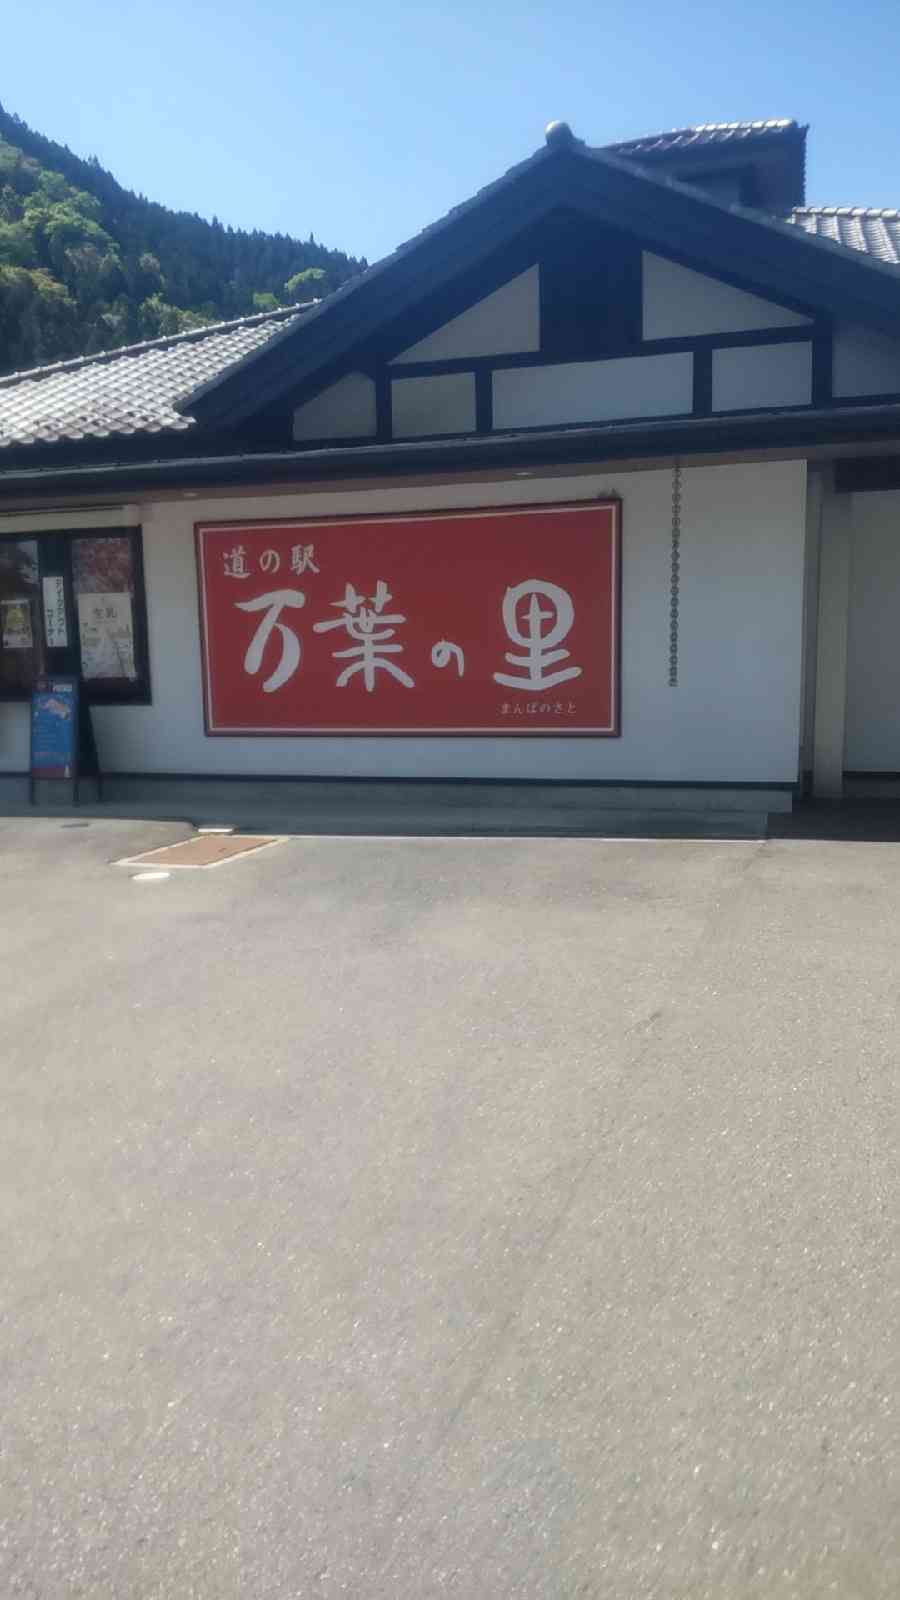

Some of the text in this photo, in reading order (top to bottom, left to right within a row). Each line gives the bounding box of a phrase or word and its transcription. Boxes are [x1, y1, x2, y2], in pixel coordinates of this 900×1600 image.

[223, 543, 320, 578] 道の駅
[234, 579, 583, 693] 万葉の里
[500, 702, 577, 714] まんばのさと
